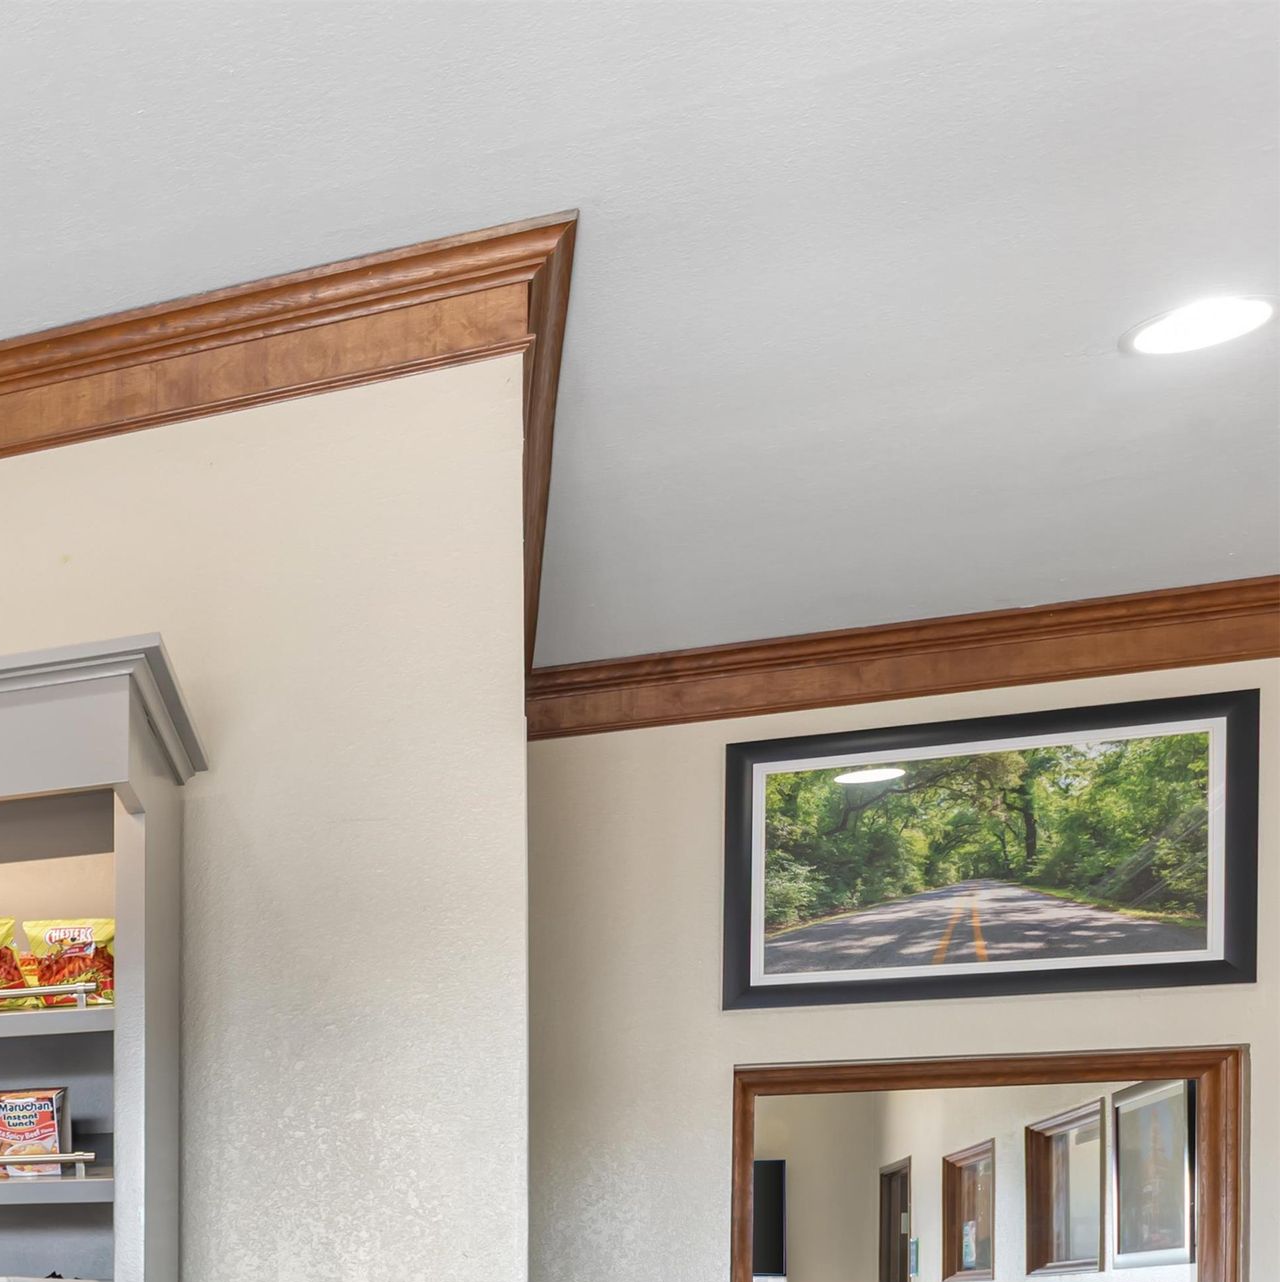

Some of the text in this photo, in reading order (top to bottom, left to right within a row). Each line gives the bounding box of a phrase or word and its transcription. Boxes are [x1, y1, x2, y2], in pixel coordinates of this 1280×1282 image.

[0, 1101, 50, 1112] Maruchan
[3, 1112, 38, 1121] Instant
[7, 1120, 35, 1128] Lunch
